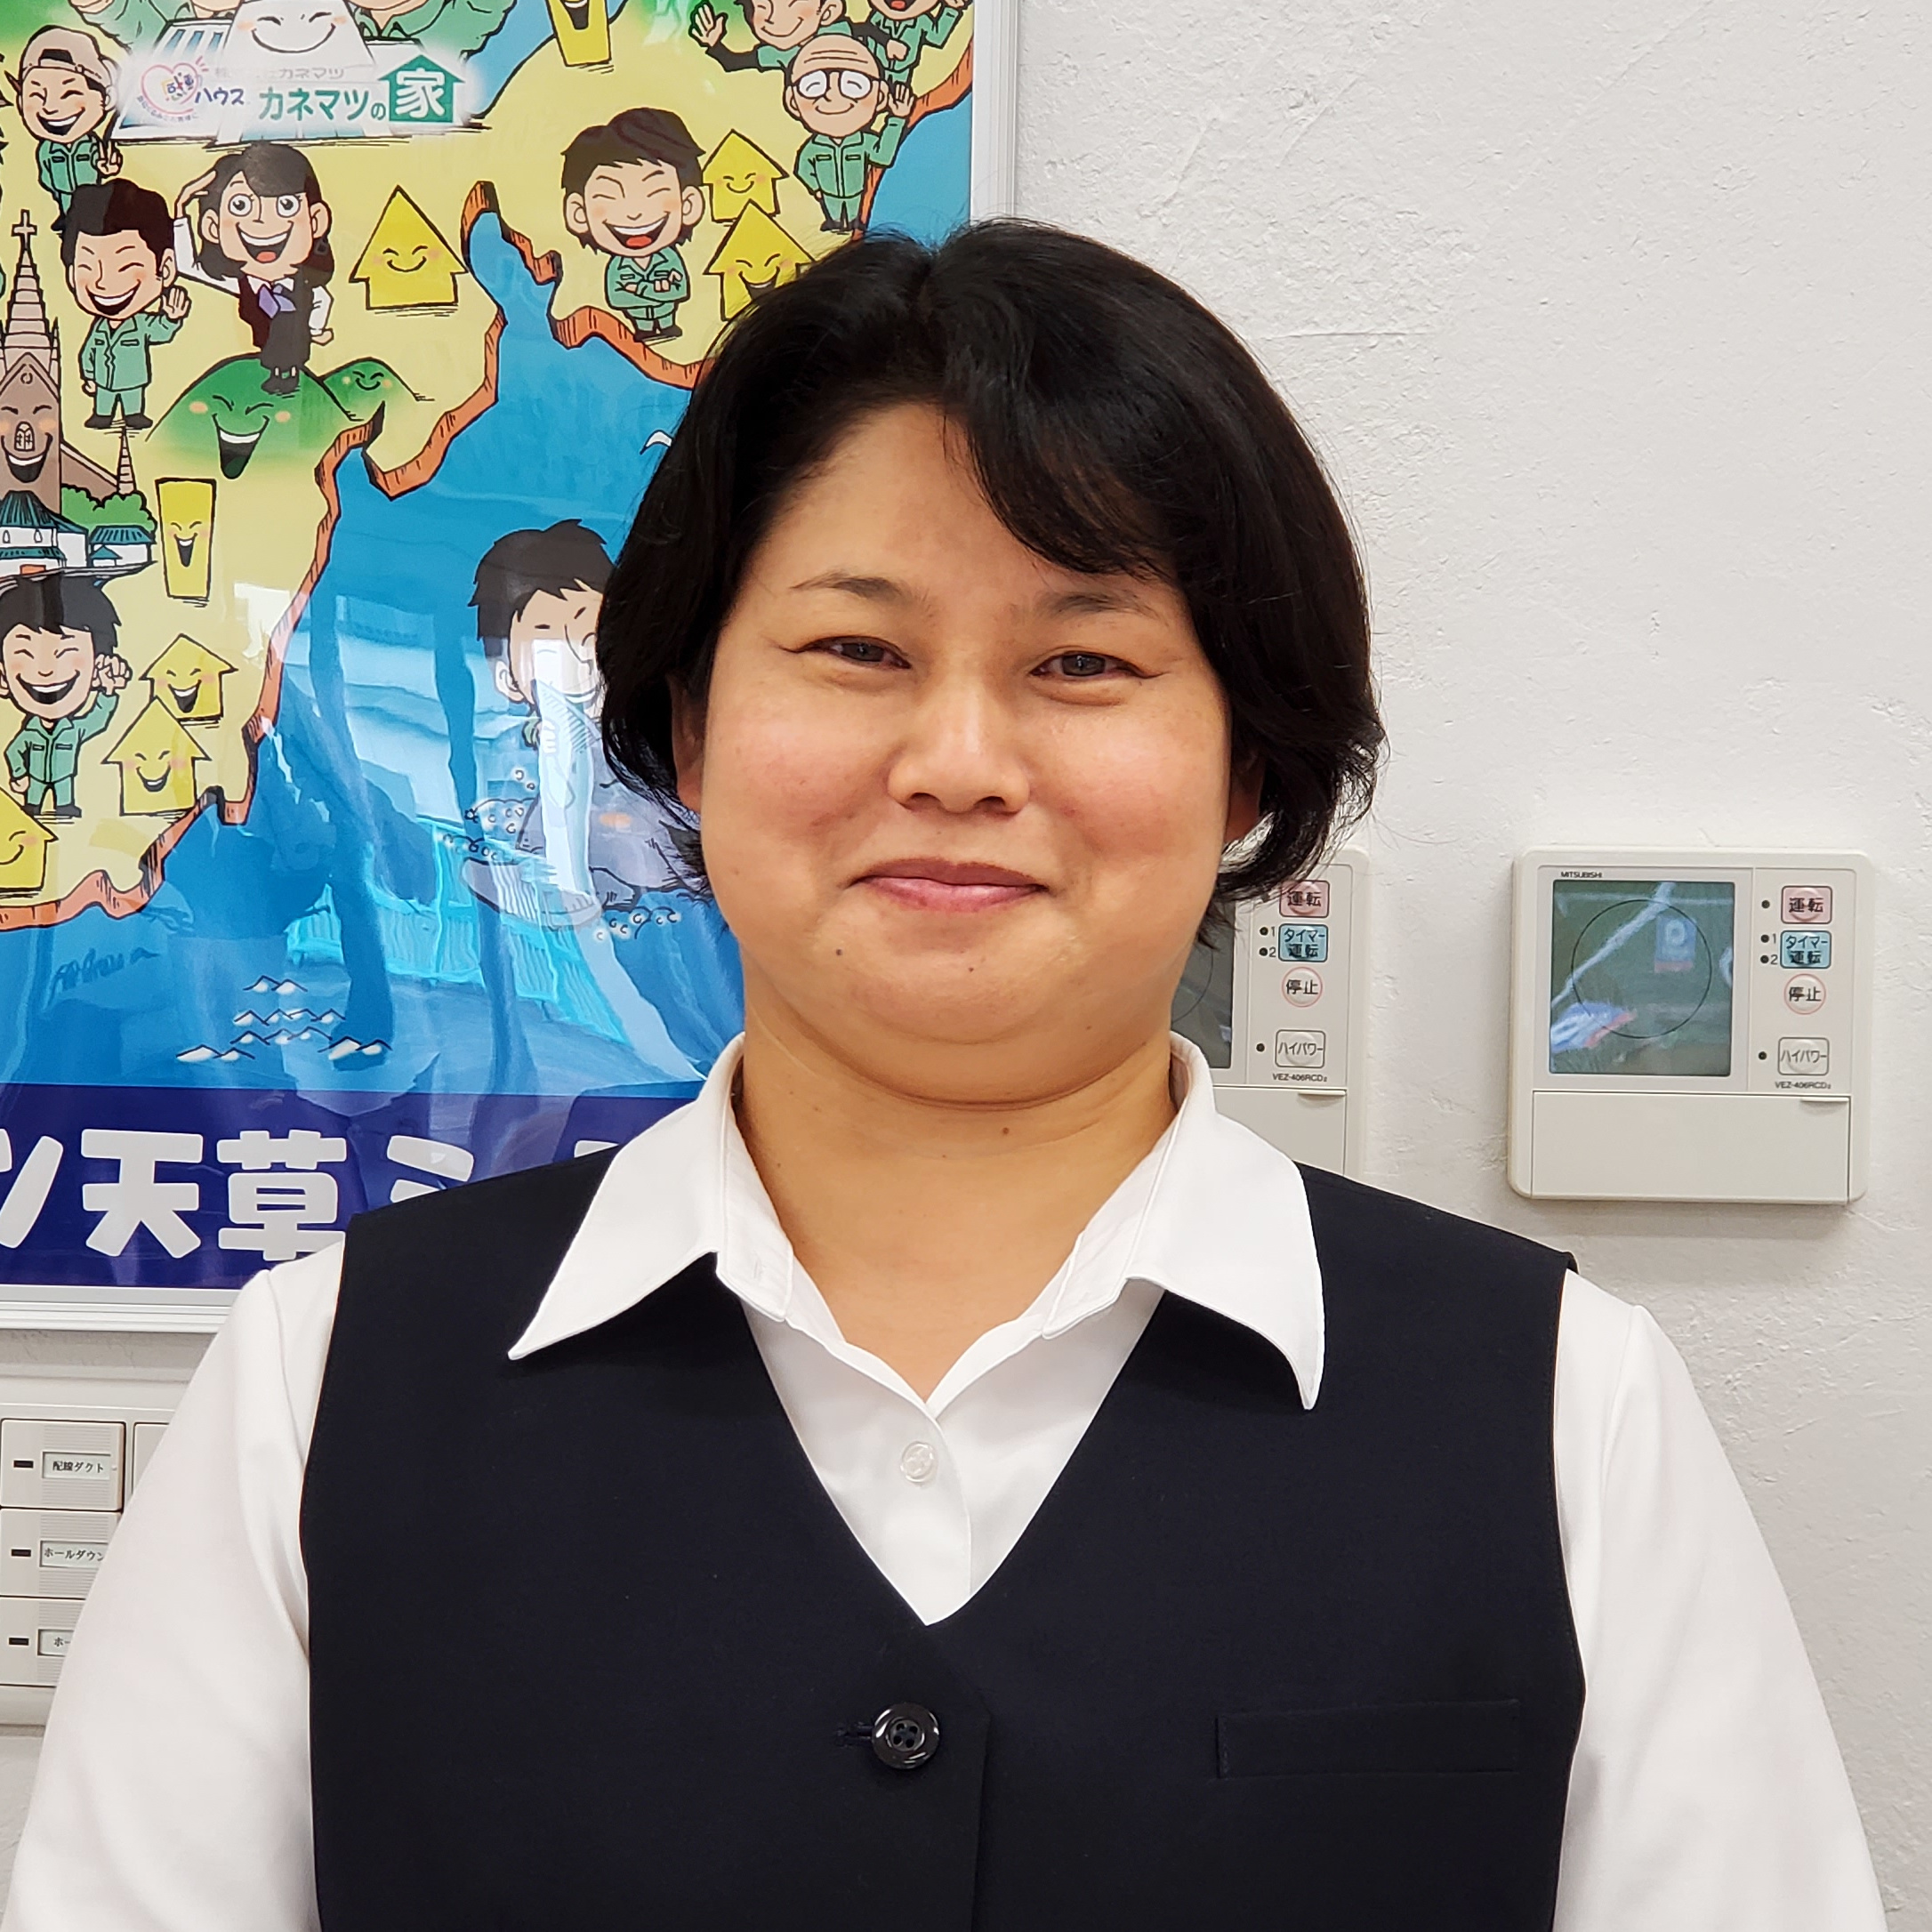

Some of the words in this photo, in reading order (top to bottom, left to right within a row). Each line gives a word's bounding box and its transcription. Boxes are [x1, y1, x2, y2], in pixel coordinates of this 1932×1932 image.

[259, 67, 445, 121] カネマツの家
[1287, 890, 1323, 907] 運転
[1788, 897, 1824, 914] 運転
[1284, 928, 1325, 942] タイマー
[1785, 935, 1828, 949] タイマー
[1268, 947, 1276, 958] 2
[1287, 943, 1319, 958] 運転
[1789, 950, 1822, 965] 運転
[1770, 954, 1778, 965] 2
[1285, 979, 1318, 995] 停止
[1788, 986, 1822, 1002] 停止
[1278, 1042, 1324, 1056] ハイパワー
[1780, 1049, 1828, 1064] ハイパワー
[52, 1461, 104, 1473] 配線ダクト
